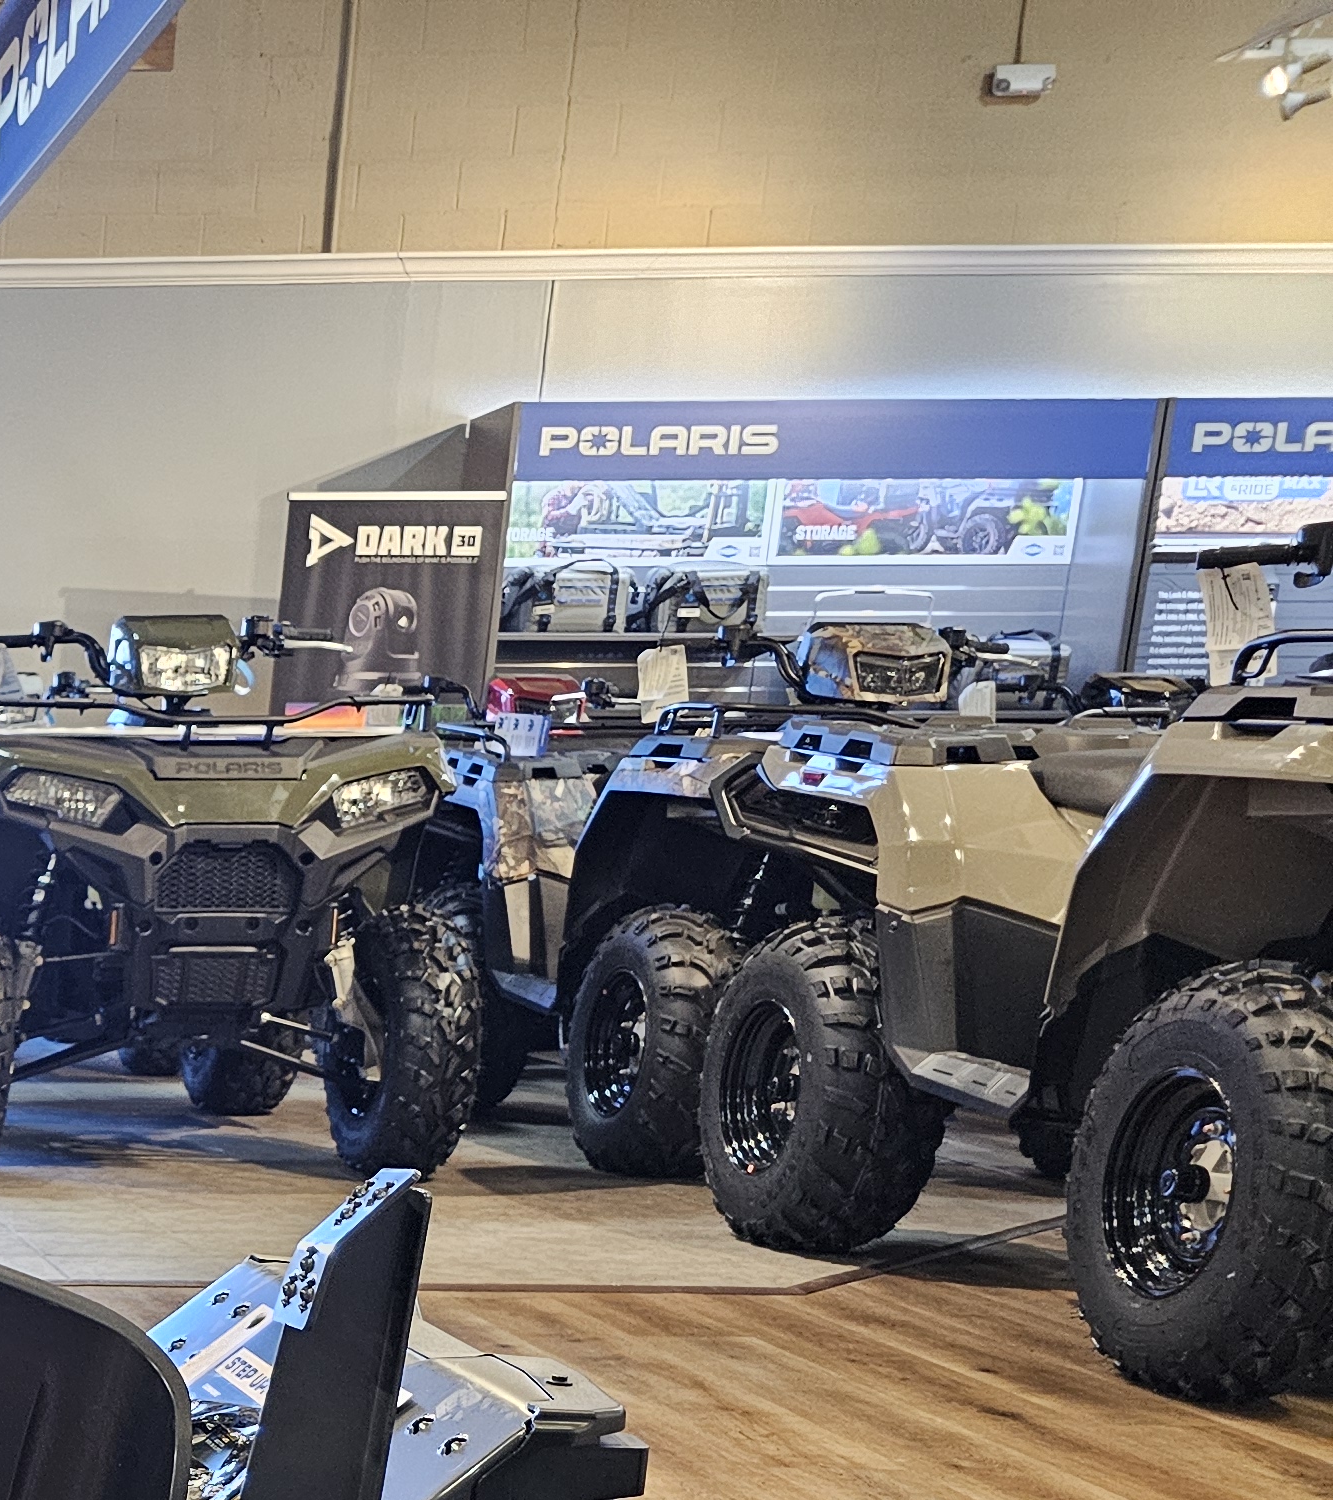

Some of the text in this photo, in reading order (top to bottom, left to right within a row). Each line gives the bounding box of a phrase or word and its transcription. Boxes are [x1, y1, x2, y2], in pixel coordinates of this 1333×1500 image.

[539, 424, 780, 456] POLARIS
[1282, 476, 1322, 490] MAX
[355, 525, 450, 556] DARK
[794, 523, 858, 541] STORAGE
[175, 761, 283, 775] POLARIS
[225, 1356, 259, 1380] STEP
